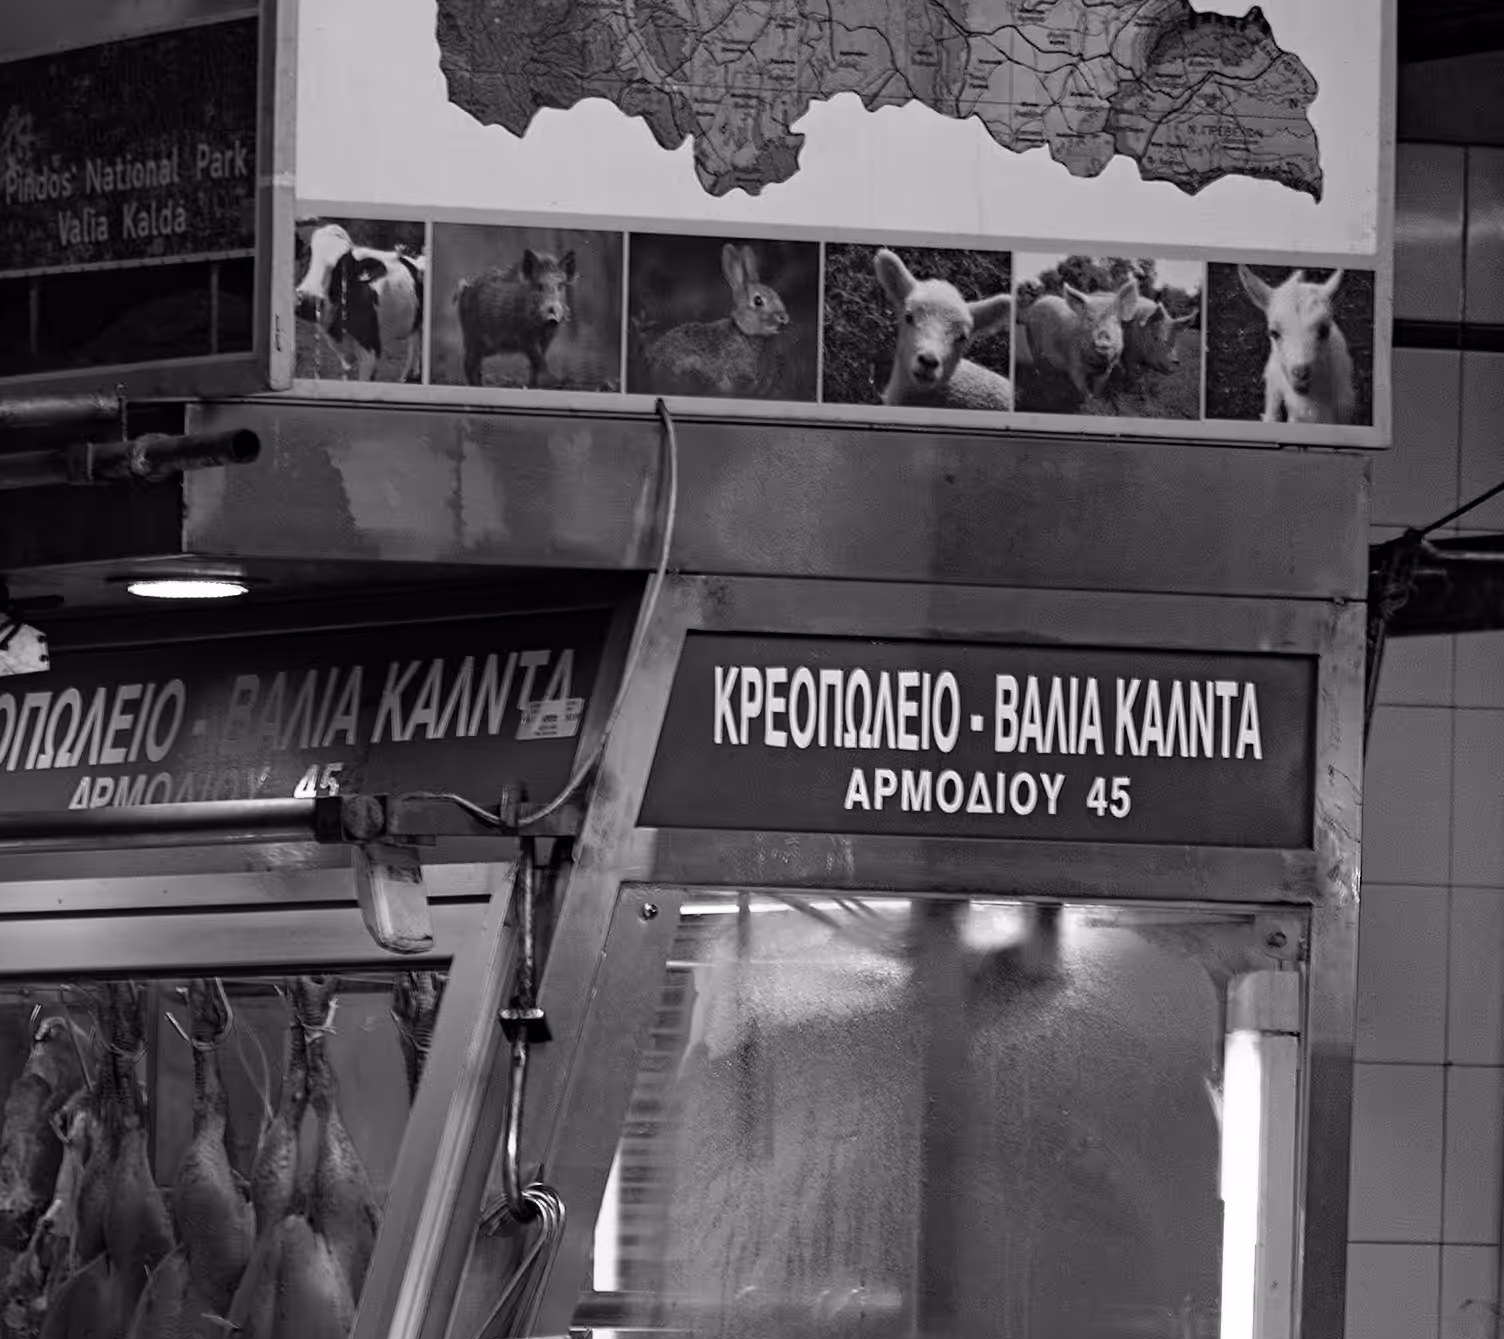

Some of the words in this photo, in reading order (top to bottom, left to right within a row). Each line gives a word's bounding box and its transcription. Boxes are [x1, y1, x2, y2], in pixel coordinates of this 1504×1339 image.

[86, 146, 179, 195] National
[196, 140, 248, 181] Park
[218, 664, 364, 754] ΒΑΛΙΑ
[714, 665, 961, 753] ΚΡΕΟΠΩΛΕΙΟ
[995, 673, 1105, 756] ΒΑΛΙΑ
[1115, 677, 1263, 760] ΚΑΛΝΤΑ
[843, 766, 1066, 816] ΑΡΜΟΔΙΟΥ
[1086, 775, 1131, 819] 45
